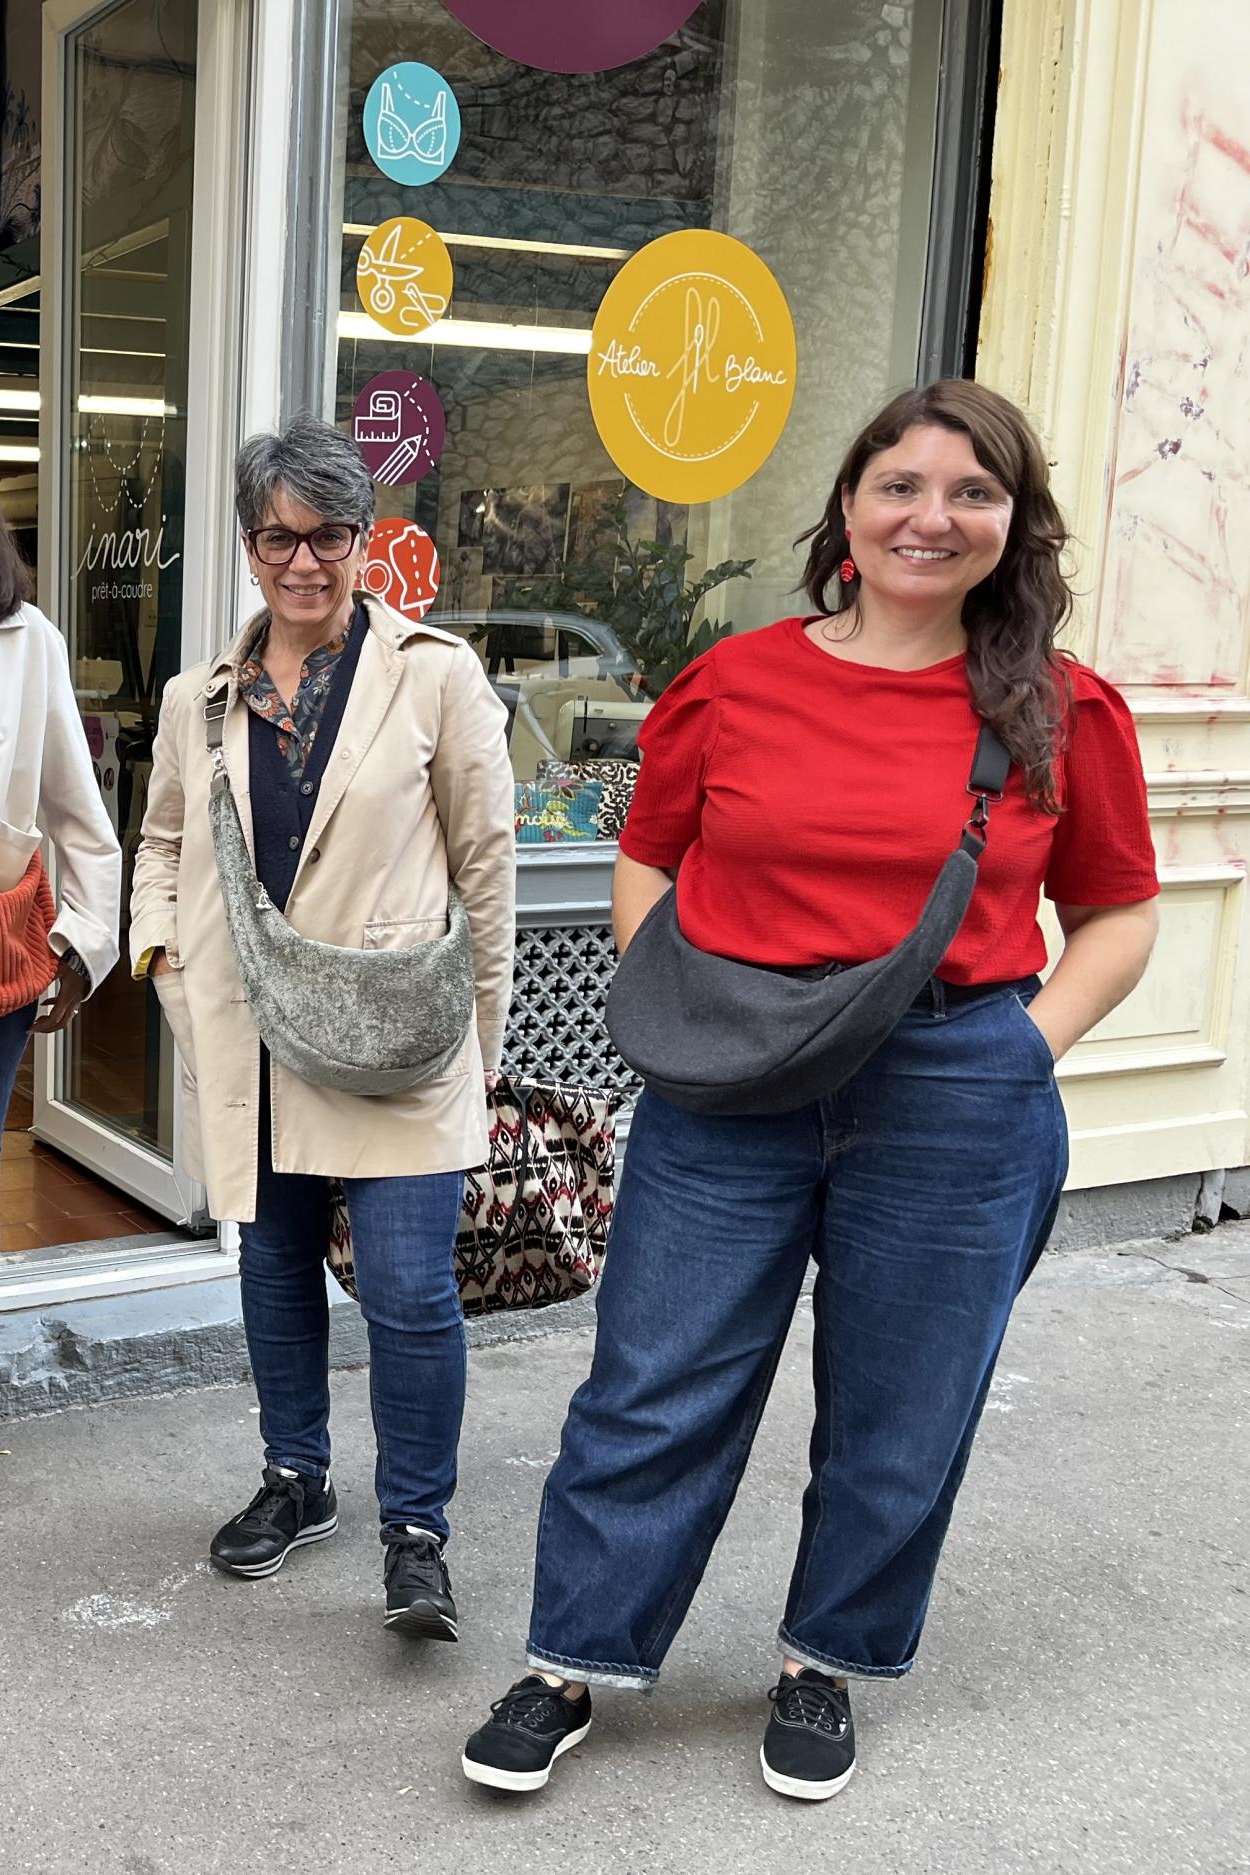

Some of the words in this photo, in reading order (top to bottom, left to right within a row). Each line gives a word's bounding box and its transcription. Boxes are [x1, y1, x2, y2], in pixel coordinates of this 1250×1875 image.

[597, 339, 661, 378] Atelier
[725, 354, 787, 392] Blanc
[70, 514, 180, 580] inari
[91, 579, 153, 603] prêt-à-coudre
